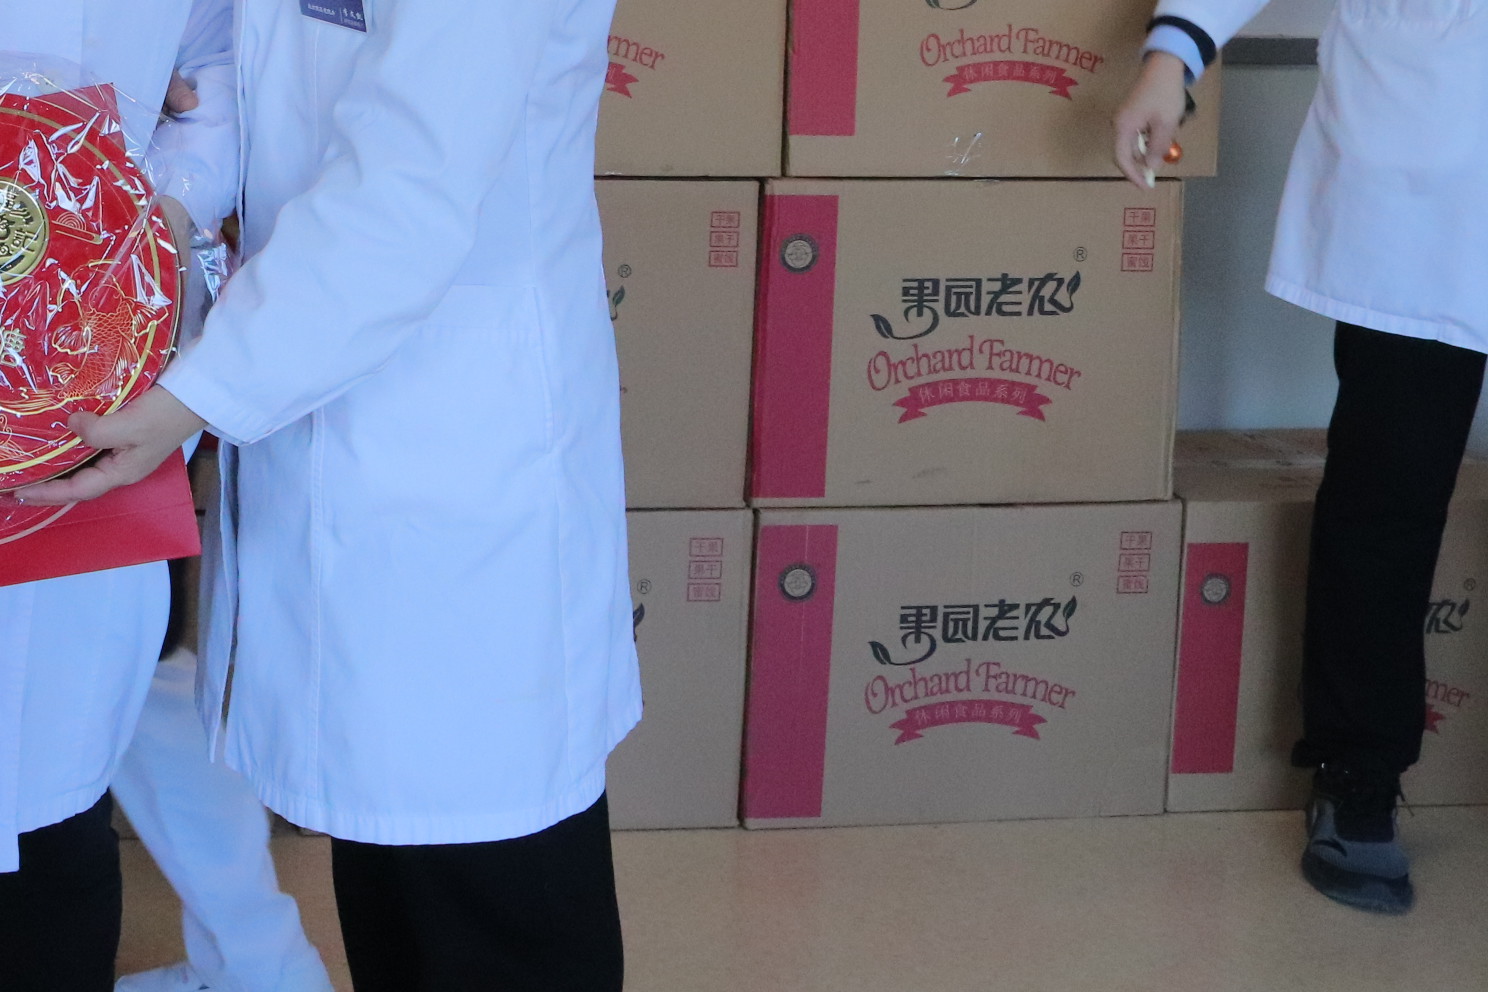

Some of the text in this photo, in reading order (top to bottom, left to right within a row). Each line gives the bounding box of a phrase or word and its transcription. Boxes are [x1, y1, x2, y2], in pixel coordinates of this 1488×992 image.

[920, 24, 1104, 74] Orchard Farmer
[901, 271, 1081, 329] 果园老农
[866, 335, 1082, 392] Orchard Farmer
[918, 381, 1028, 405] 休闲食品系列
[899, 595, 1078, 654] 果园老农
[864, 659, 1077, 715] Orchard Farmer
